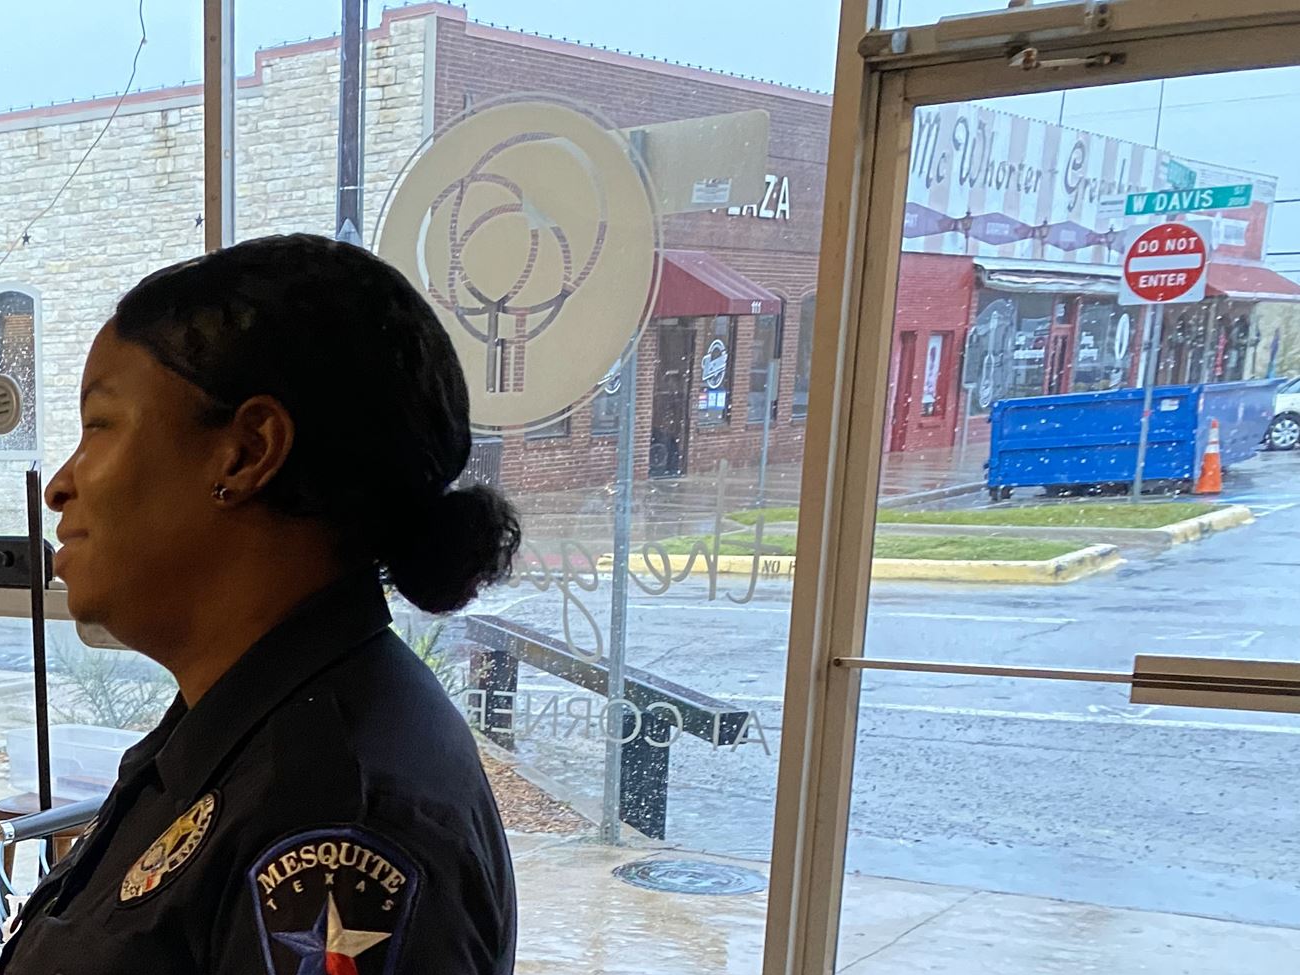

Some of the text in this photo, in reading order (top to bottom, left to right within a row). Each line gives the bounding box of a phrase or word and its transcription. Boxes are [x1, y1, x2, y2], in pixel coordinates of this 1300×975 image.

[1132, 194, 1148, 213] W
[1154, 189, 1214, 212] DAVIS
[1137, 236, 1198, 254] DO NOT
[1138, 273, 1187, 288] ENTER
[762, 560, 781, 574] NO
[257, 842, 406, 895] MESQUITE
[266, 872, 394, 912] TEXAS
